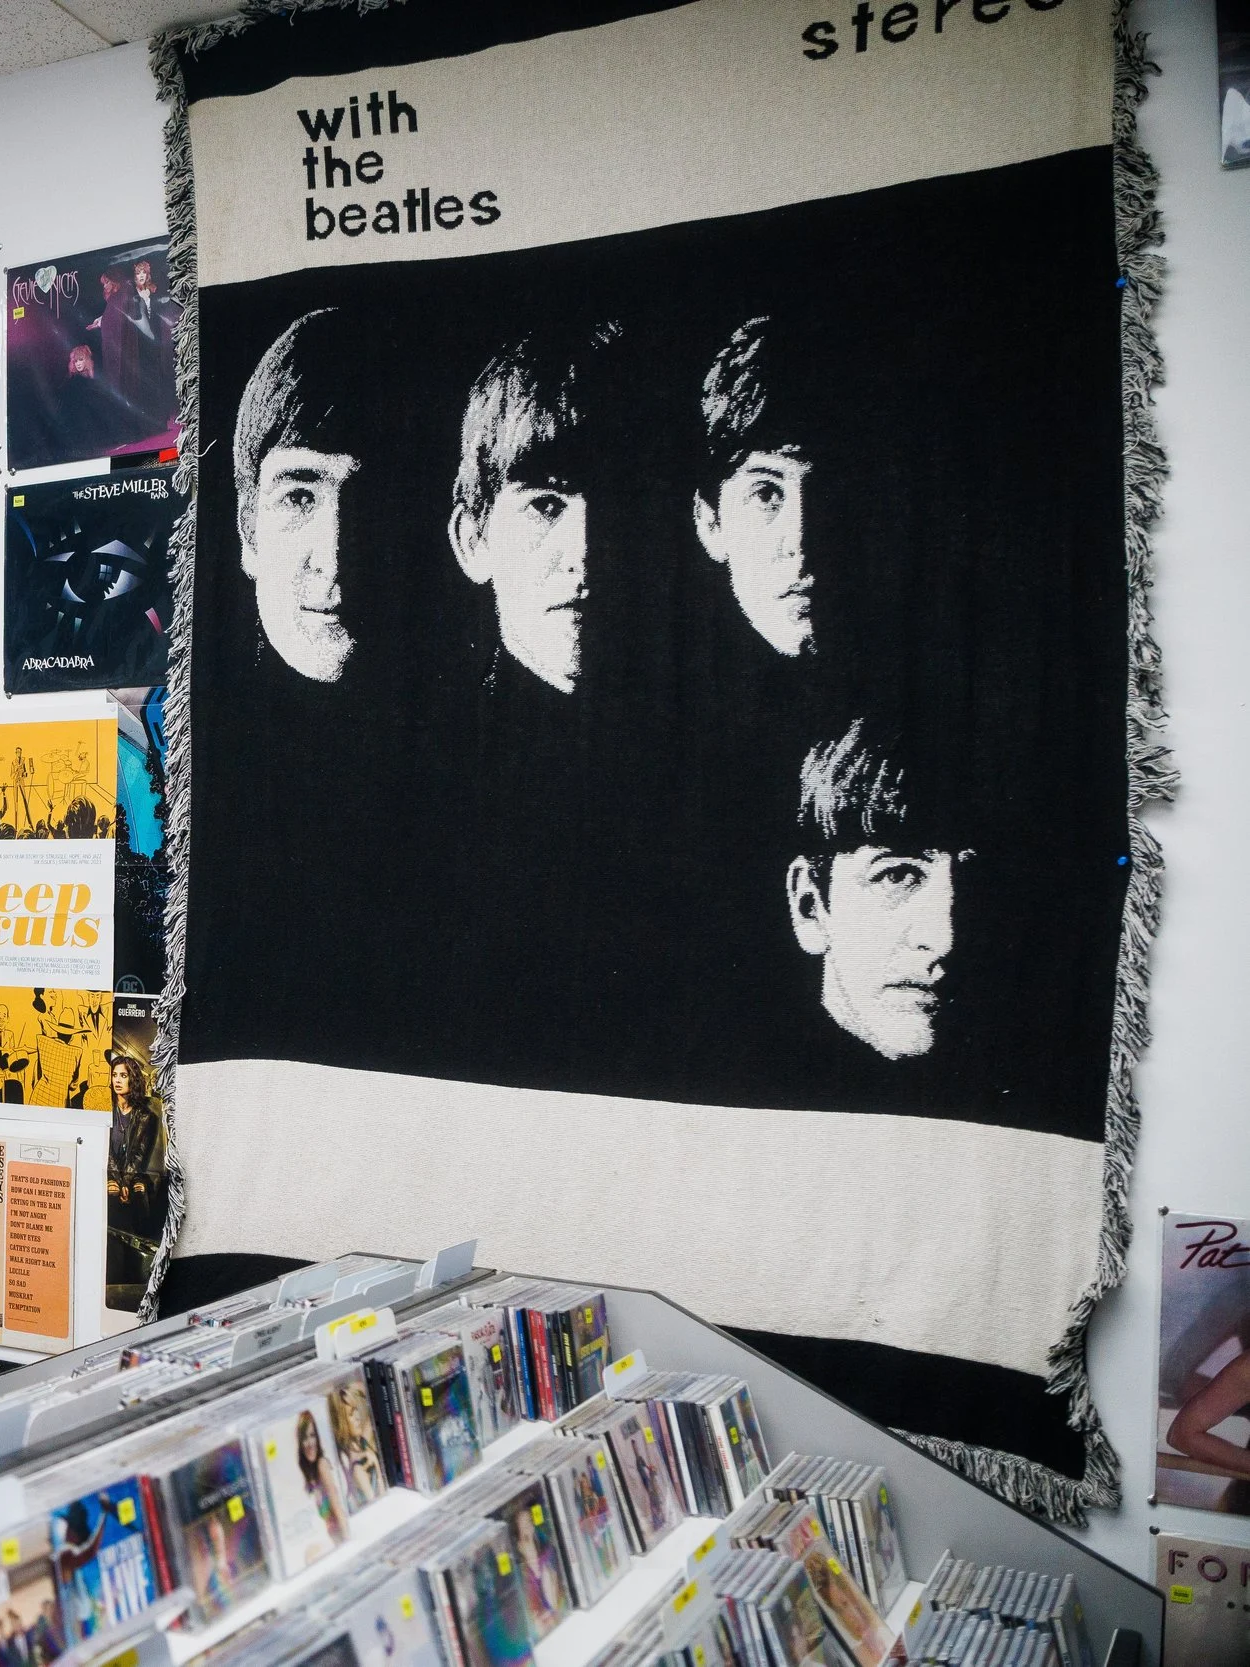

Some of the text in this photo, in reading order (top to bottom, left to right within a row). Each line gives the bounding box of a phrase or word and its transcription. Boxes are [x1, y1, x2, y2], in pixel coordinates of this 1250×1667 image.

[801, 0, 1064, 60] stere
[297, 90, 418, 142] with
[302, 146, 384, 190] the
[306, 187, 501, 240] beatles
[72, 479, 166, 500] THE STEVE MILLER
[150, 490, 169, 499] BAND
[22, 654, 95, 672] ABRACADABRA
[118, 1008, 145, 1018] GUERRERO
[11, 1175, 28, 1183] THAT'S
[40, 1178, 70, 1188] FASHIONED
[10, 1186, 23, 1194] HOW
[23, 1187, 34, 1195] CAN
[37, 1189, 53, 1197] MEET
[53, 1191, 66, 1199] HER
[10, 1198, 29, 1207] CRYING
[36, 1201, 48, 1209] THE
[48, 1202, 62, 1210] RAIN
[19, 1210, 30, 1218] NOT
[29, 1212, 47, 1220] ANGRY
[10, 1220, 54, 1233] DON'T BLAME ME
[10, 1232, 41, 1242] EBONY EYES
[9, 1243, 50, 1255] CATHY'S CLOWN
[9, 1255, 56, 1268] WALK RIGHT BACK
[9, 1267, 31, 1277] LUCILLE
[9, 1278, 27, 1288] SO SAD
[8, 1290, 33, 1301] MUSKRAT
[8, 1302, 41, 1314] TEMPTATION
